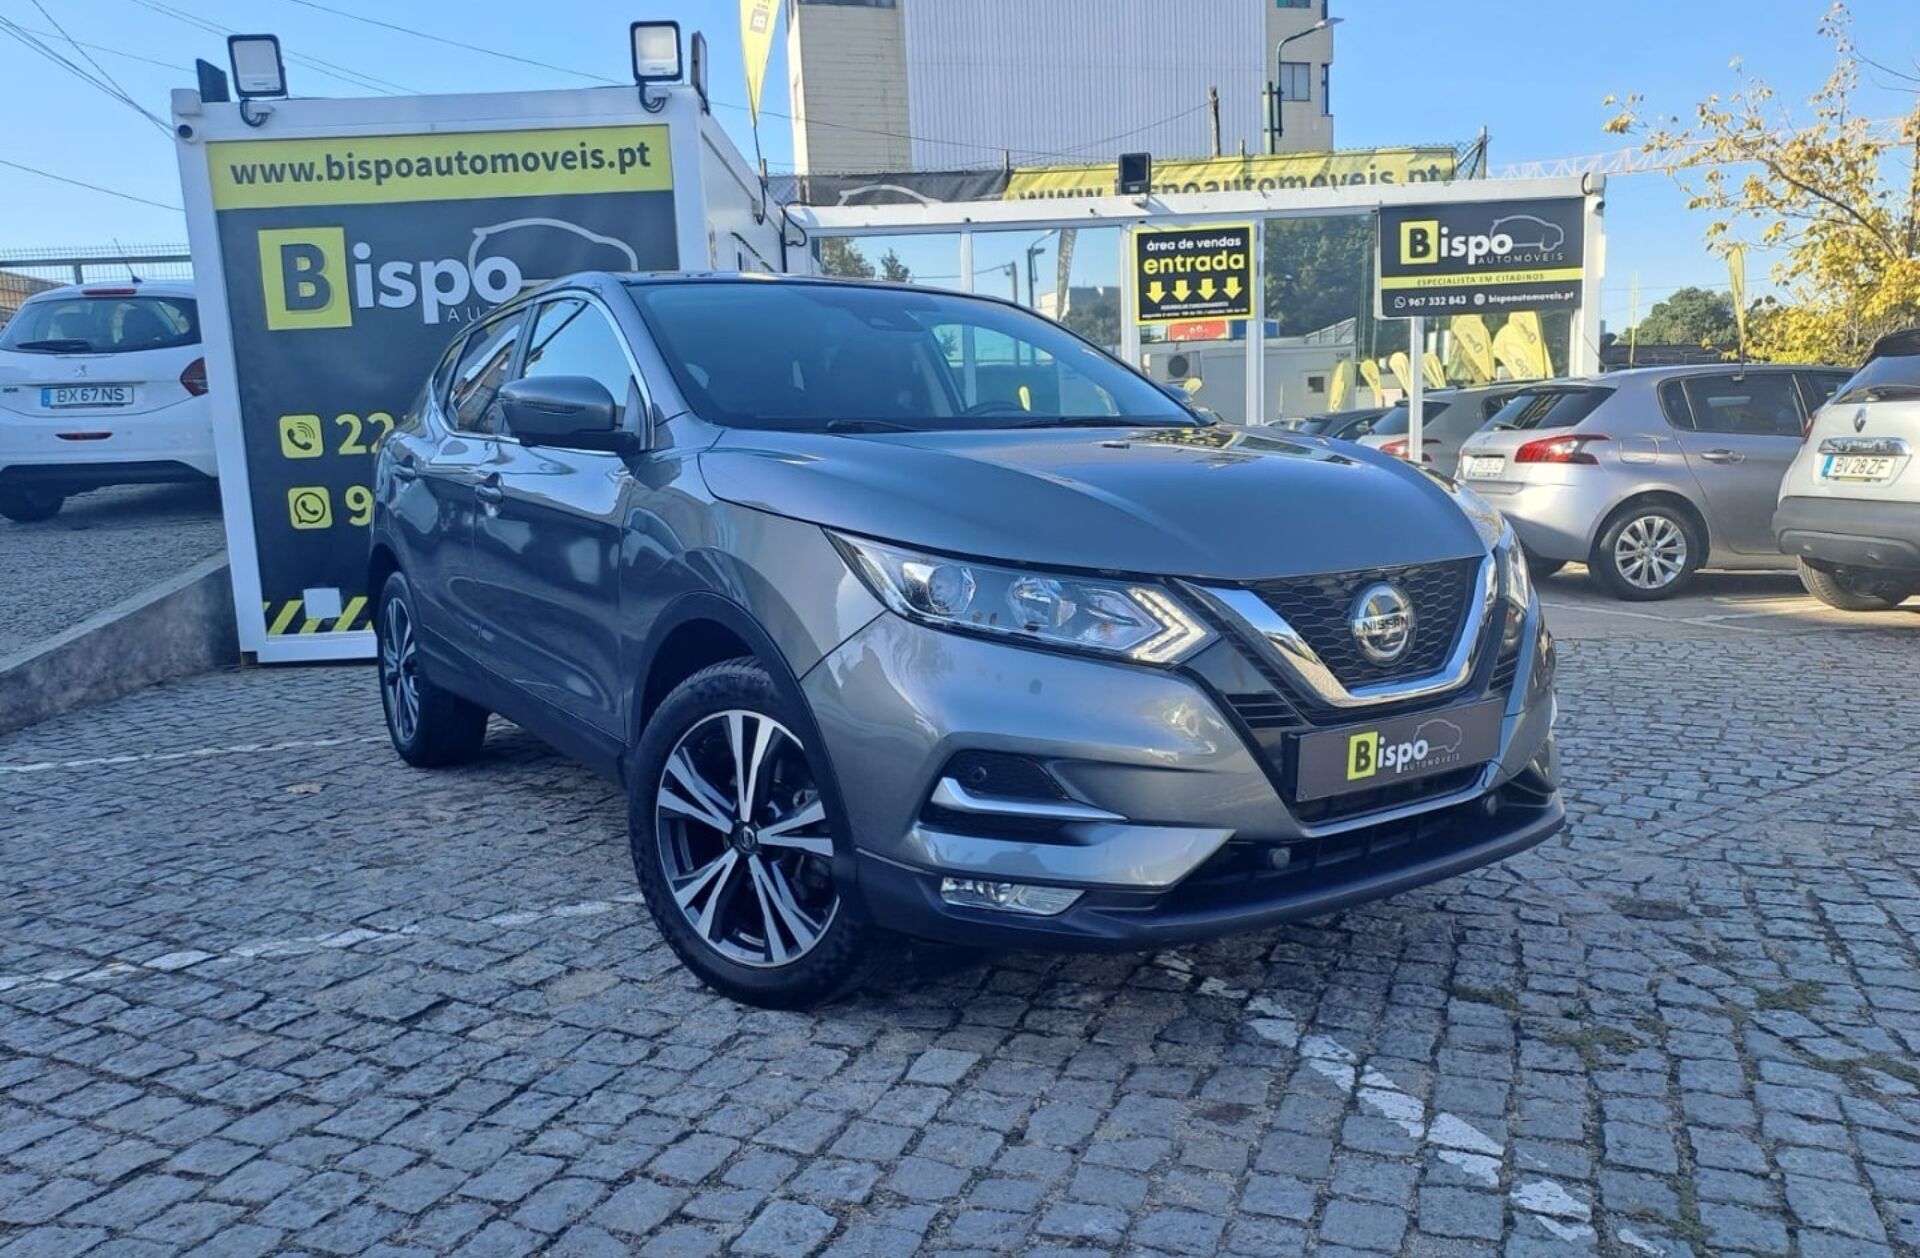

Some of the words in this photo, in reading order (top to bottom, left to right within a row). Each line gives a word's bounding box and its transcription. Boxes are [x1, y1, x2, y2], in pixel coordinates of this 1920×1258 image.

[230, 141, 651, 186] www.bispoautomoveis.pt
[1146, 240, 1176, 252] área
[1178, 238, 1194, 250] de
[1197, 236, 1242, 248] vendas
[1409, 226, 1514, 265] Bispo
[1143, 250, 1245, 274] entrada
[1478, 251, 1564, 264] AUTOMÓVEIS
[280, 242, 522, 324] Bispo
[1417, 275, 1476, 286] ESPECIALISTA
[1480, 274, 1493, 283] EM
[1496, 272, 1544, 282] CITADINOS
[1408, 297, 1426, 307] 967
[447, 306, 499, 323] AU
[1362, 614, 1409, 632] NISSAN
[1354, 737, 1429, 774] Bispo
